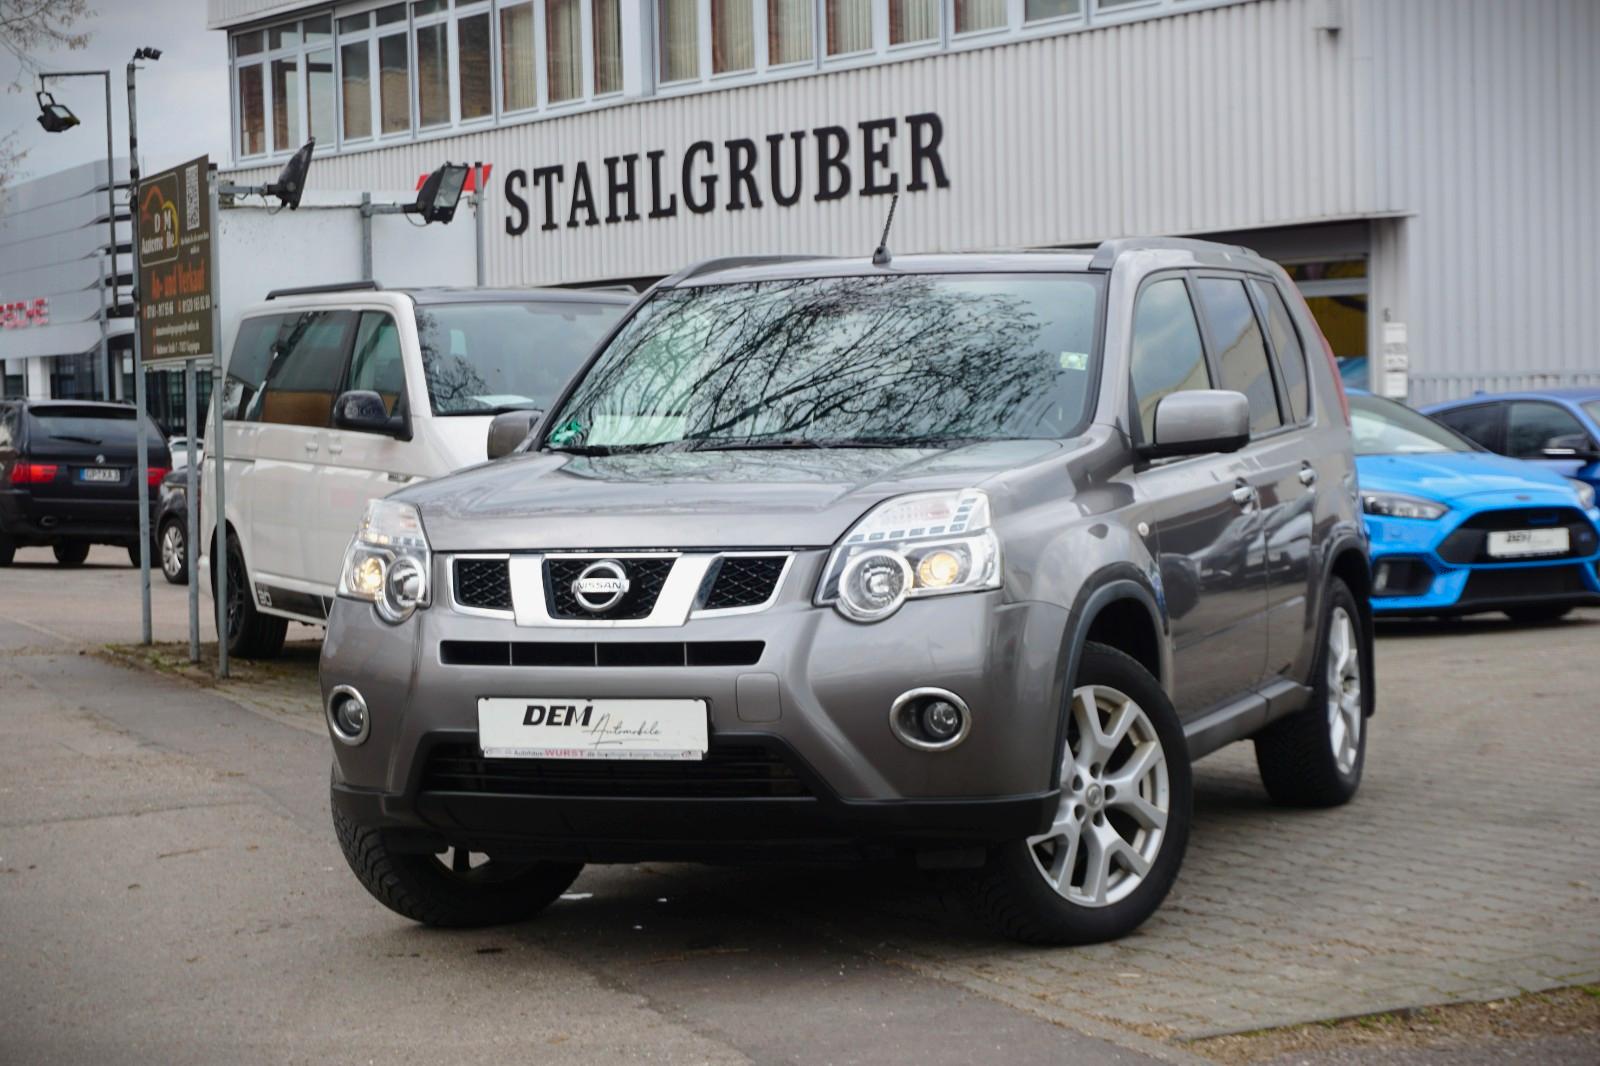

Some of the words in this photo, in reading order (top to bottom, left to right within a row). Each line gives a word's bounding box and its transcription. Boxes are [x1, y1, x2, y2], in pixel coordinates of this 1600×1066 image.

[504, 111, 950, 236] STAHLGRUBER
[142, 231, 175, 255] Automoile
[523, 705, 593, 727] DEM
[582, 712, 661, 746] Automobile
[544, 748, 584, 757] WURST
